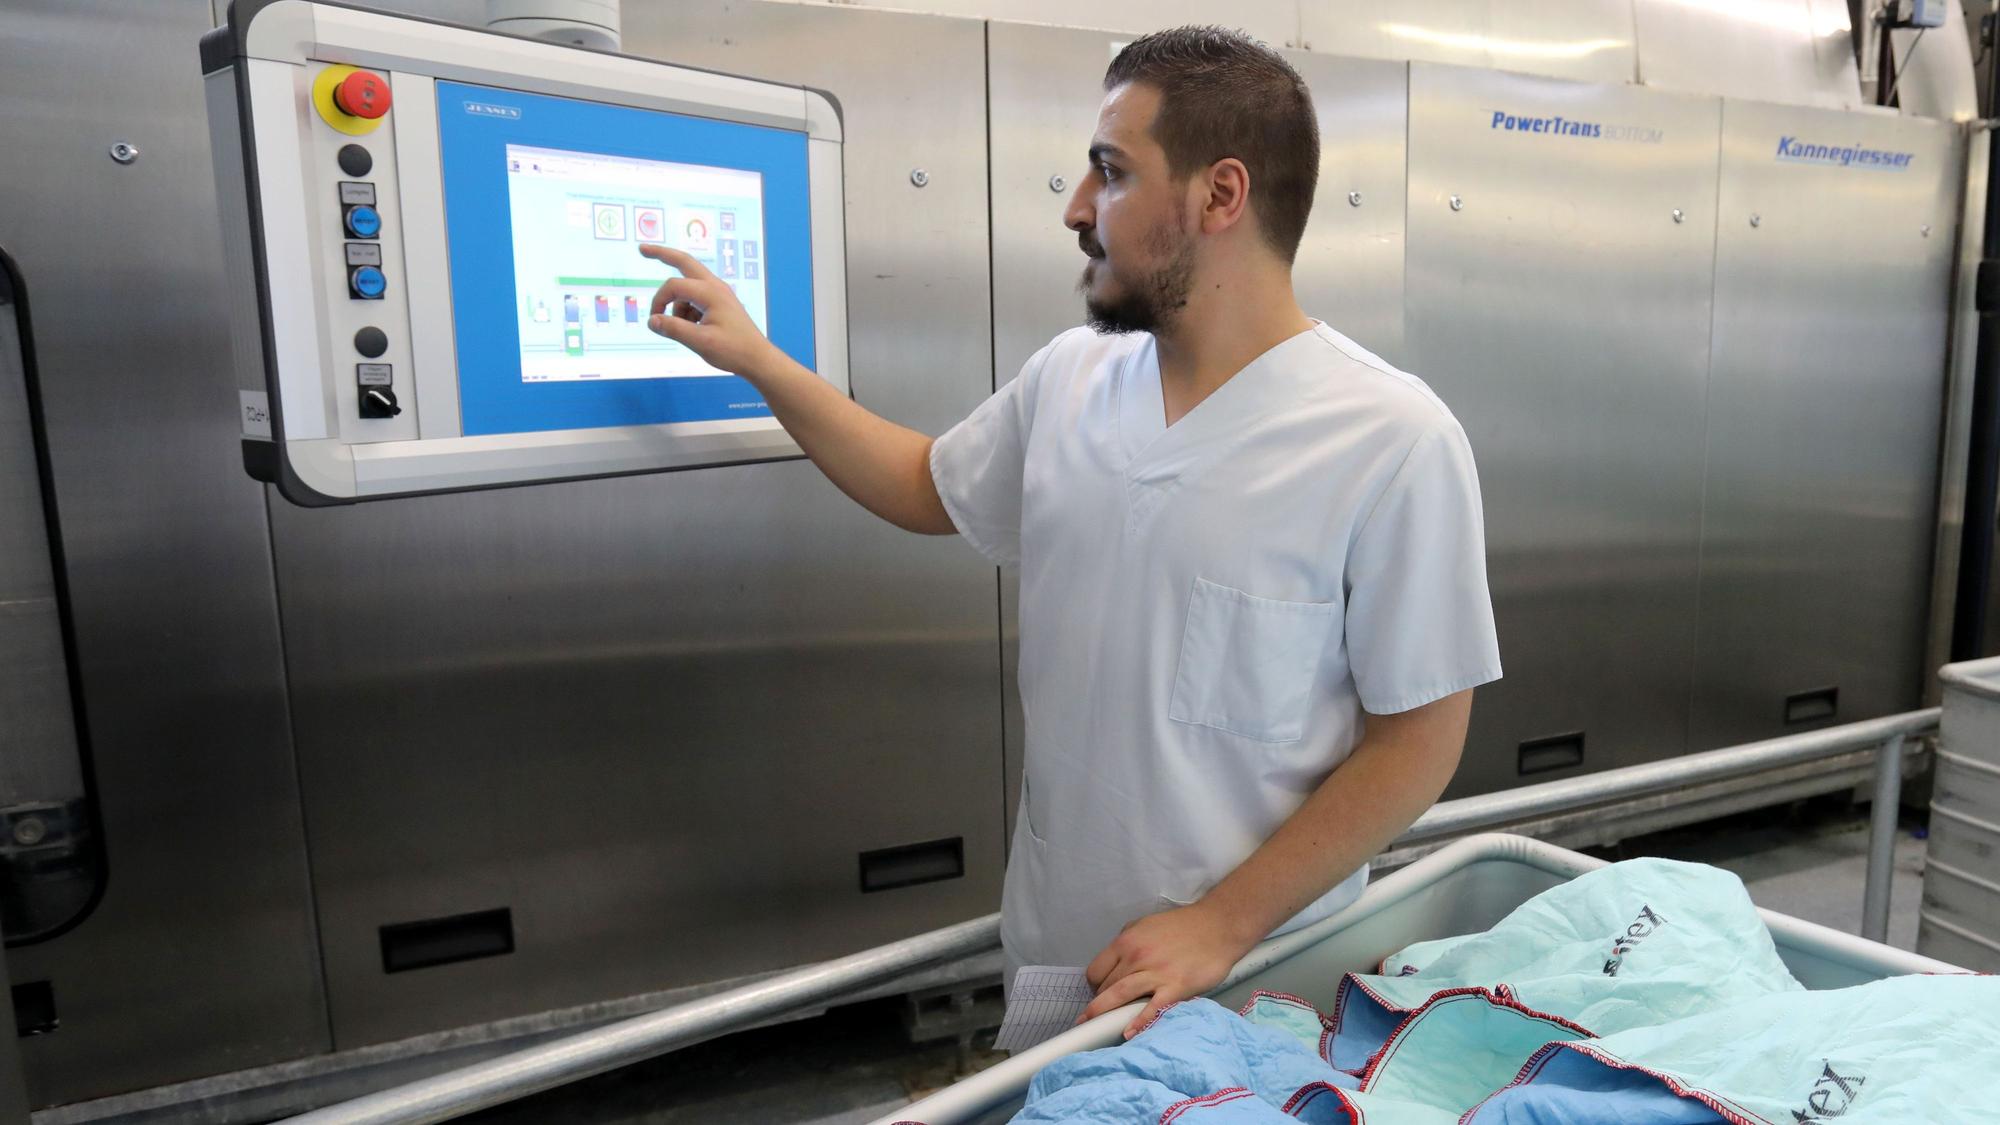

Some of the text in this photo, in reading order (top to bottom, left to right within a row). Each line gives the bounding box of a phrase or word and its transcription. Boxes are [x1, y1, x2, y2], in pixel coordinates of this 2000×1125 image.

[1491, 111, 1664, 144] PowerTrans BOTTOM
[1777, 136, 1915, 167] Kannegiesser
[1790, 1062, 1866, 1125] tex
